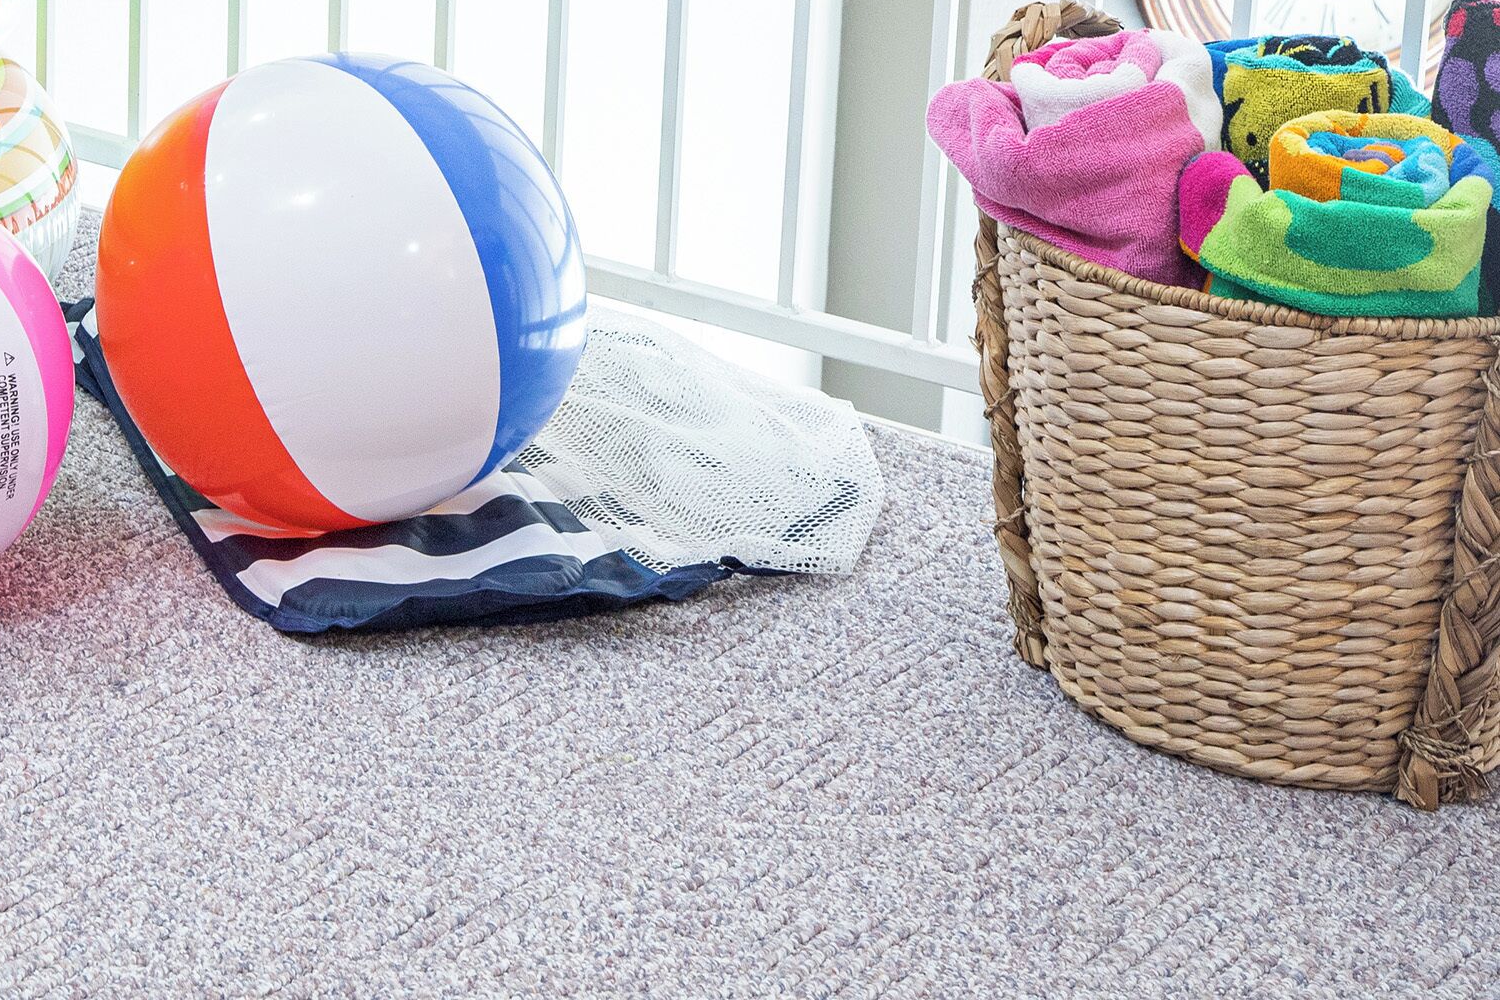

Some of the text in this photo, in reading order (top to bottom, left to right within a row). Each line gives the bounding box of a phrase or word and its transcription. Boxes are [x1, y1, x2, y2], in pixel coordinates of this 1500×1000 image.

[6, 373, 20, 500] WARNING! USE ONLY UNDER
